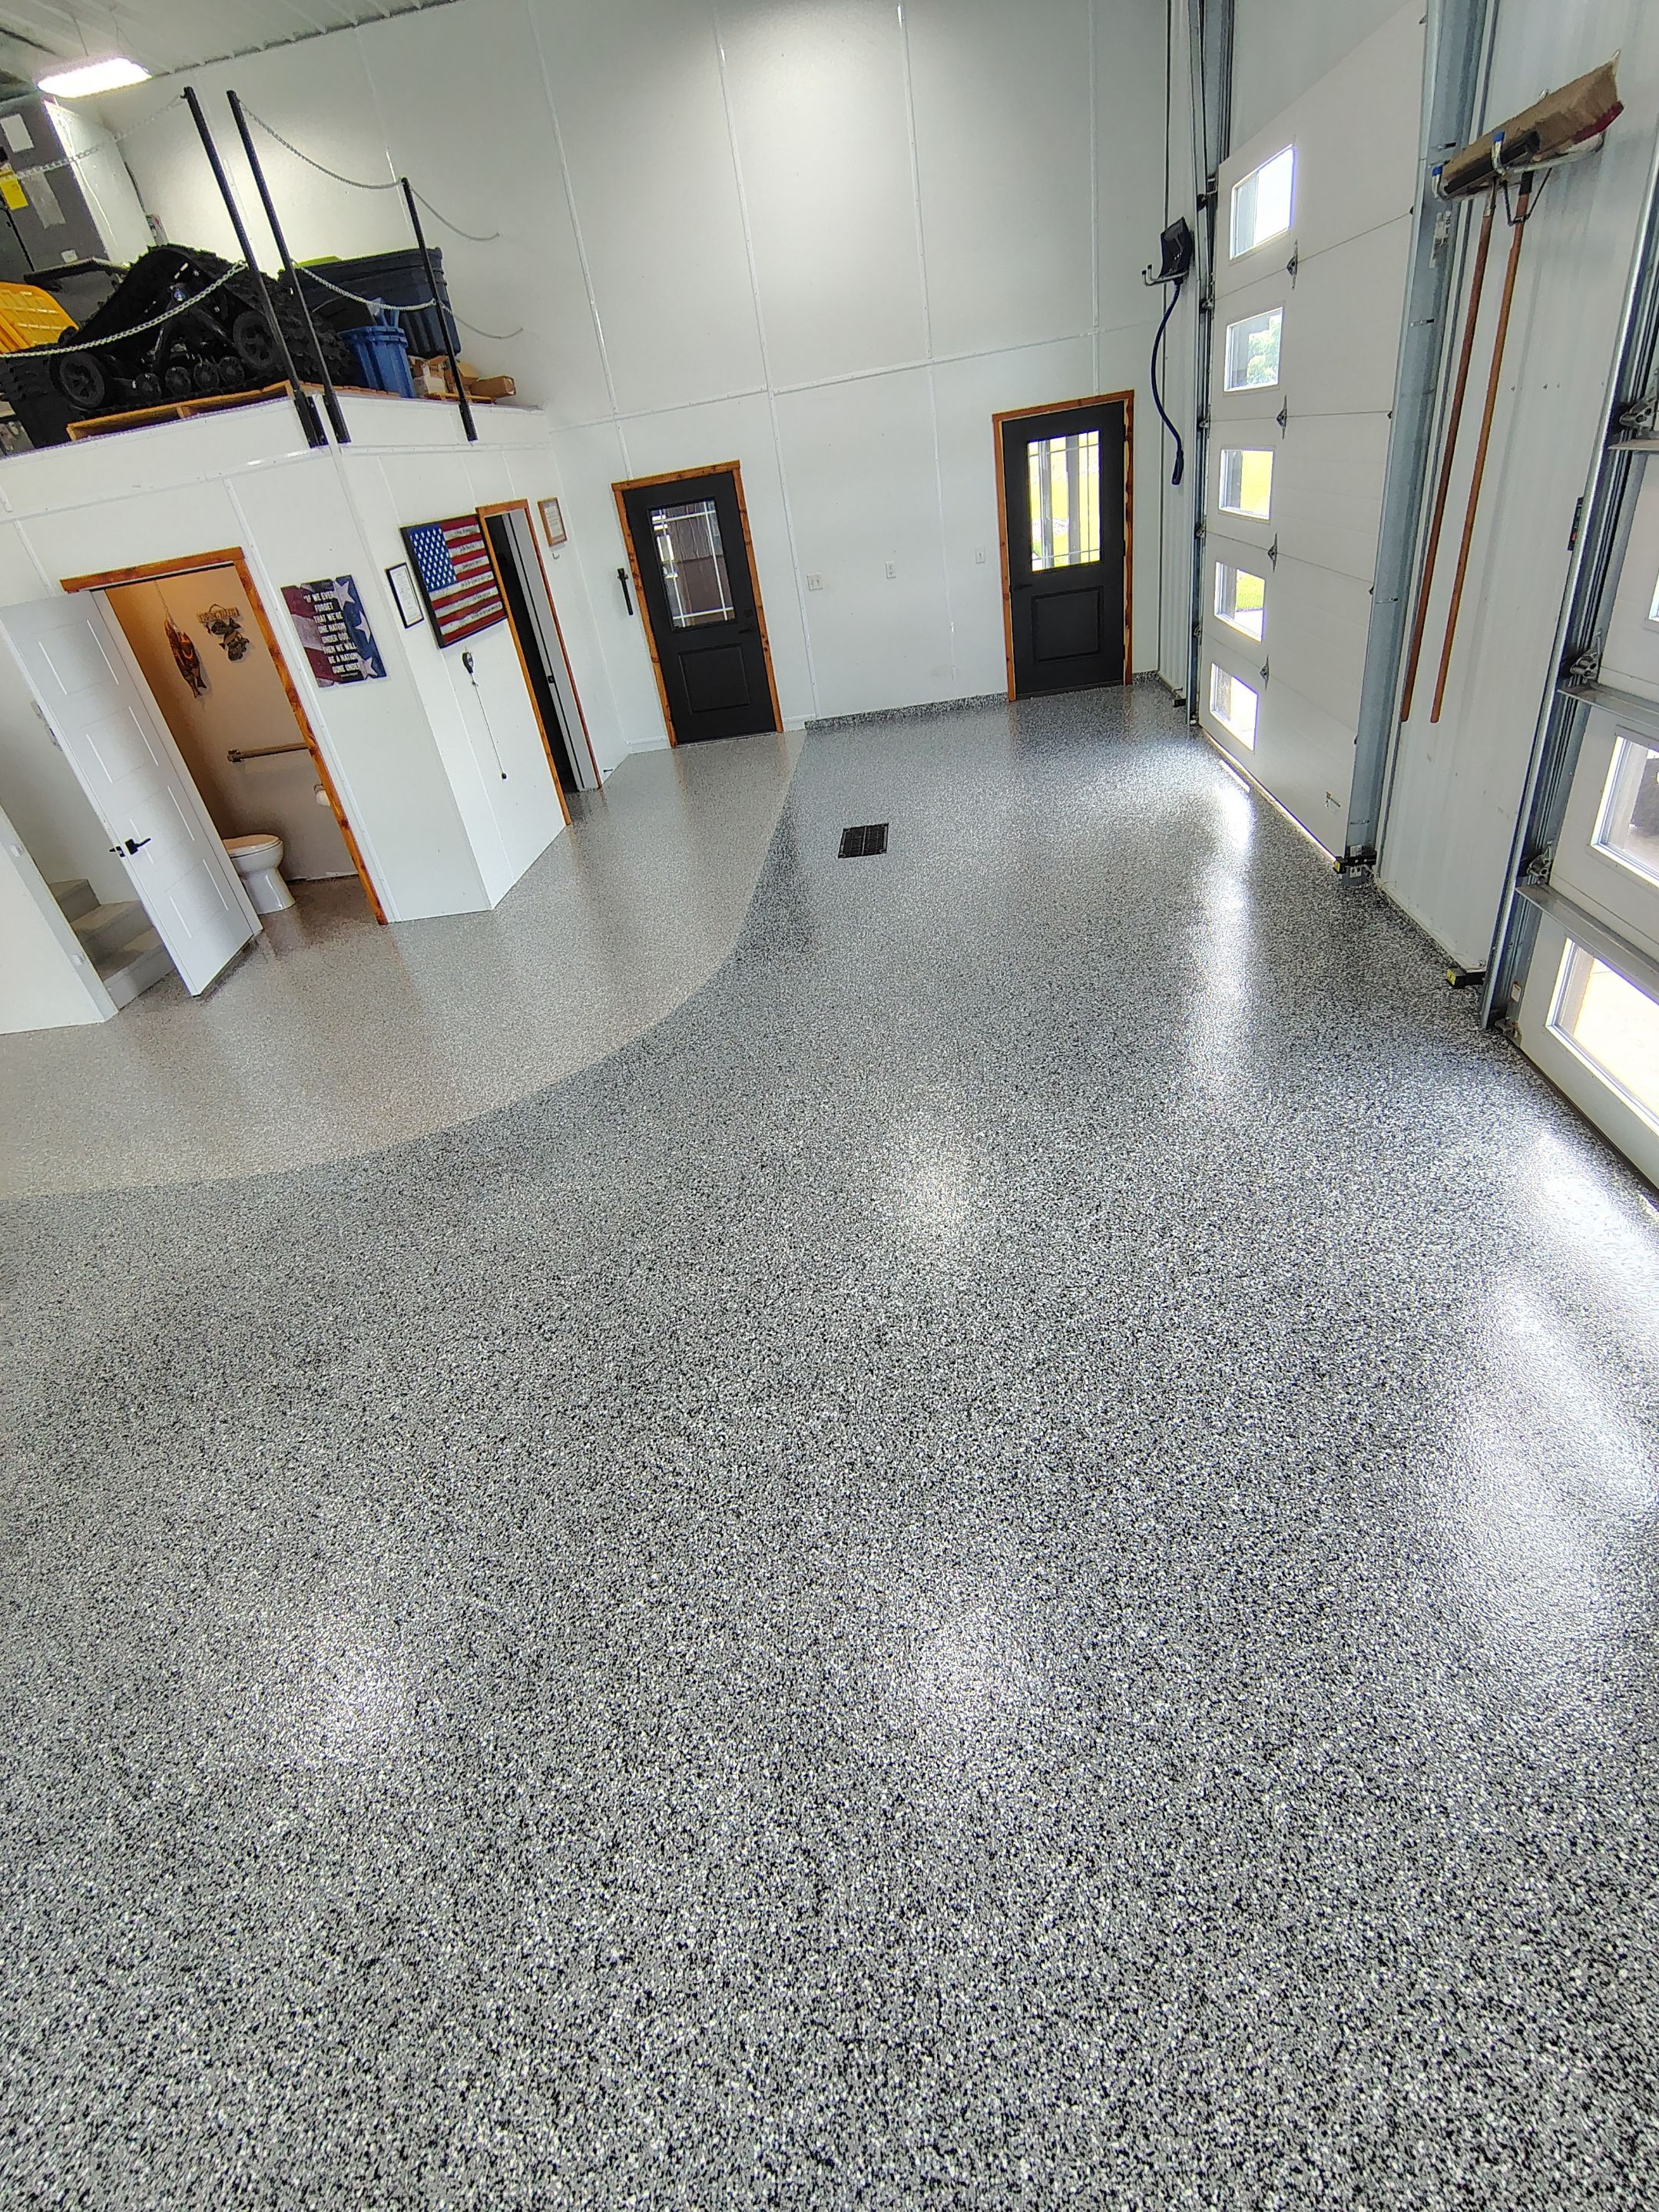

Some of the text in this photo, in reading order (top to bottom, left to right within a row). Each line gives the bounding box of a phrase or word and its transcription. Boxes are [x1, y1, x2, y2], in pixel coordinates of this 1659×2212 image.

[312, 593, 322, 601] WE
[315, 602, 333, 613] FORGET
[313, 614, 326, 624] THAT
[318, 622, 347, 634] ONE NATION
[321, 634, 338, 644] UNDER
[323, 642, 356, 654] THEN WE WILL
[340, 652, 358, 662] NATION
[332, 665, 346, 674] GONE
